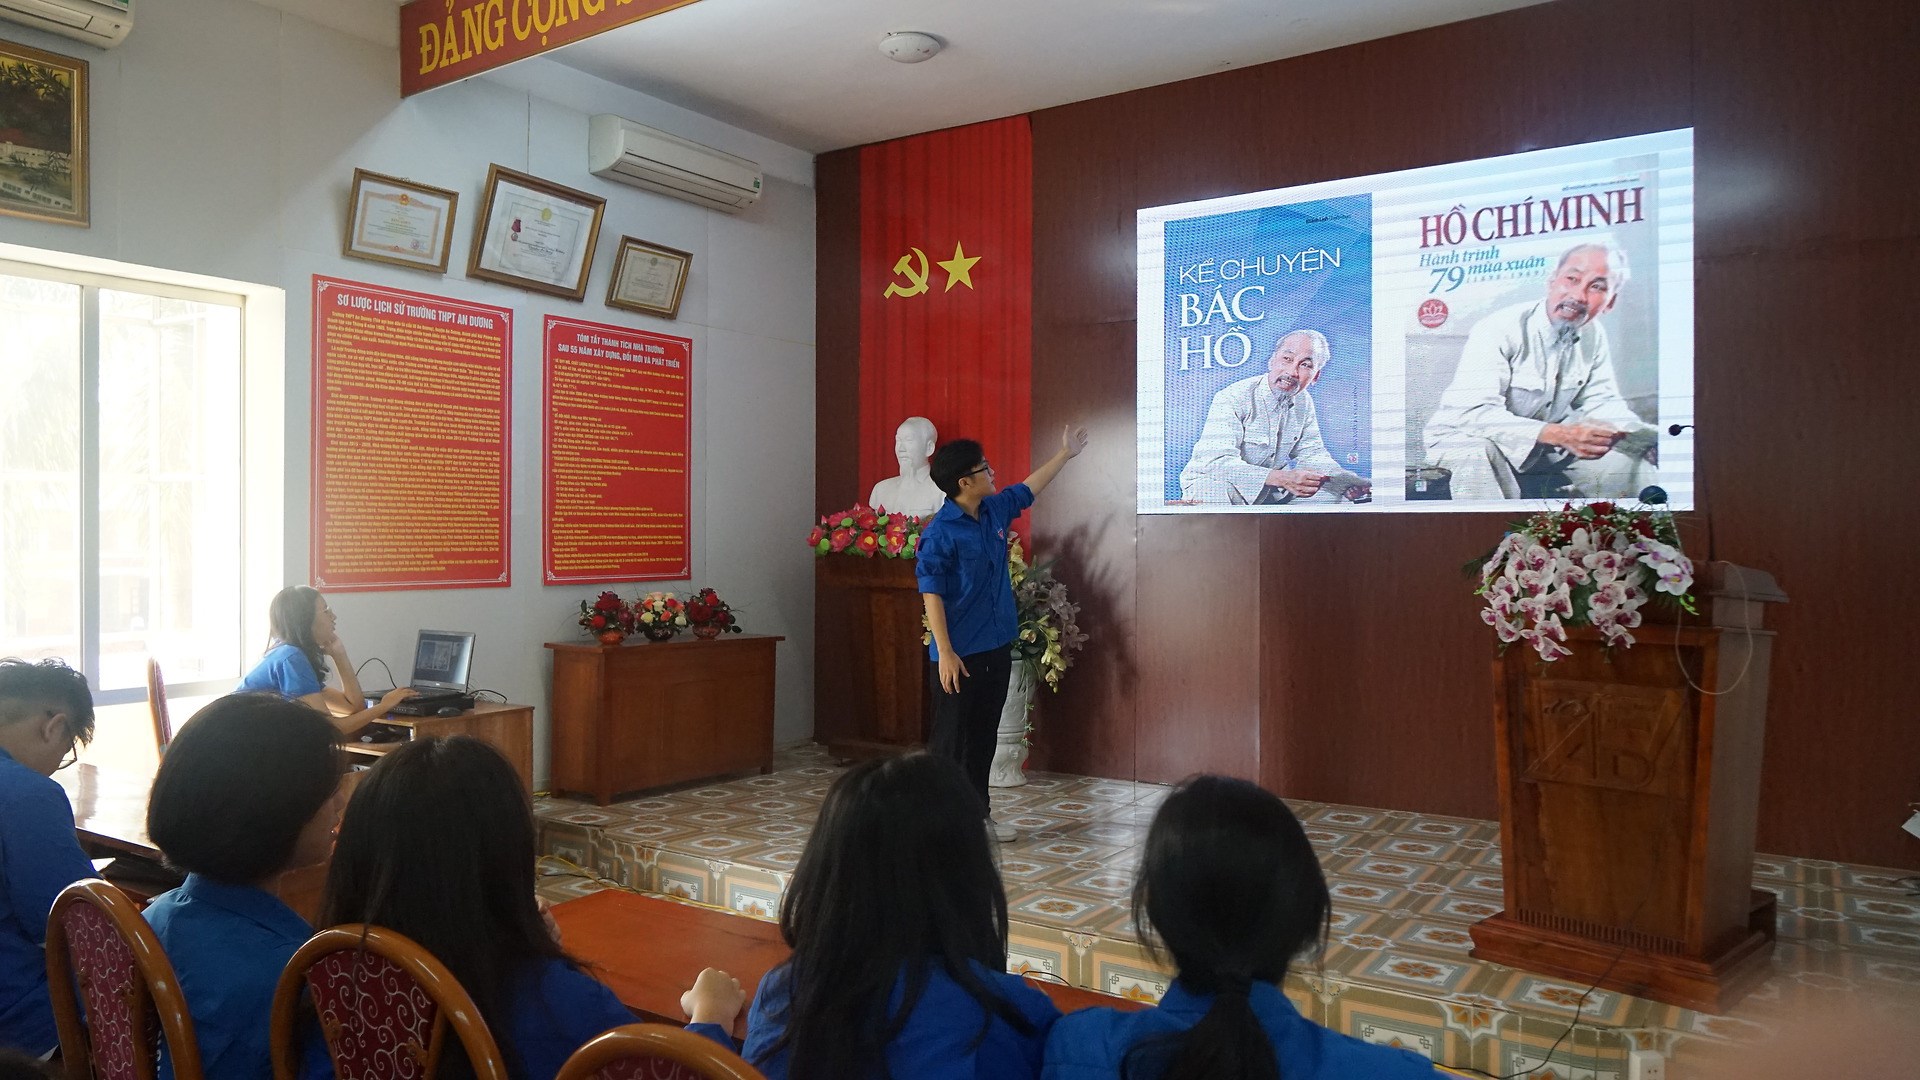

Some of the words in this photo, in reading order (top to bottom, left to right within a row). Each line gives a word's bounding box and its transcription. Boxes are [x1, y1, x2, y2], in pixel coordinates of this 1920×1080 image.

[419, 0, 507, 75] ĐẢNG
[1419, 203, 1467, 249] HỒ
[1472, 196, 1535, 242] CHÍ
[1539, 186, 1644, 234] MINH
[1179, 258, 1215, 285] KỂ
[1220, 247, 1341, 281] CHUYỆN
[1419, 248, 1459, 267] Hành
[1463, 245, 1500, 263] trình
[1429, 265, 1466, 294] 79
[1467, 260, 1507, 275] mùa
[1506, 255, 1545, 271] xuân
[337, 293, 350, 306] SƠ
[351, 295, 372, 312] LƯỢC
[374, 300, 392, 314] LỊCH
[394, 300, 406, 315] SỬ
[407, 304, 436, 321] TRƯỜNG
[438, 309, 456, 323] THPT
[457, 314, 468, 326] AN
[469, 315, 494, 330] DƯƠNG
[1178, 284, 1265, 328] BÁC
[558, 343, 570, 353] SAU
[570, 345, 578, 354] 55
[1179, 325, 1252, 371] HỒ
